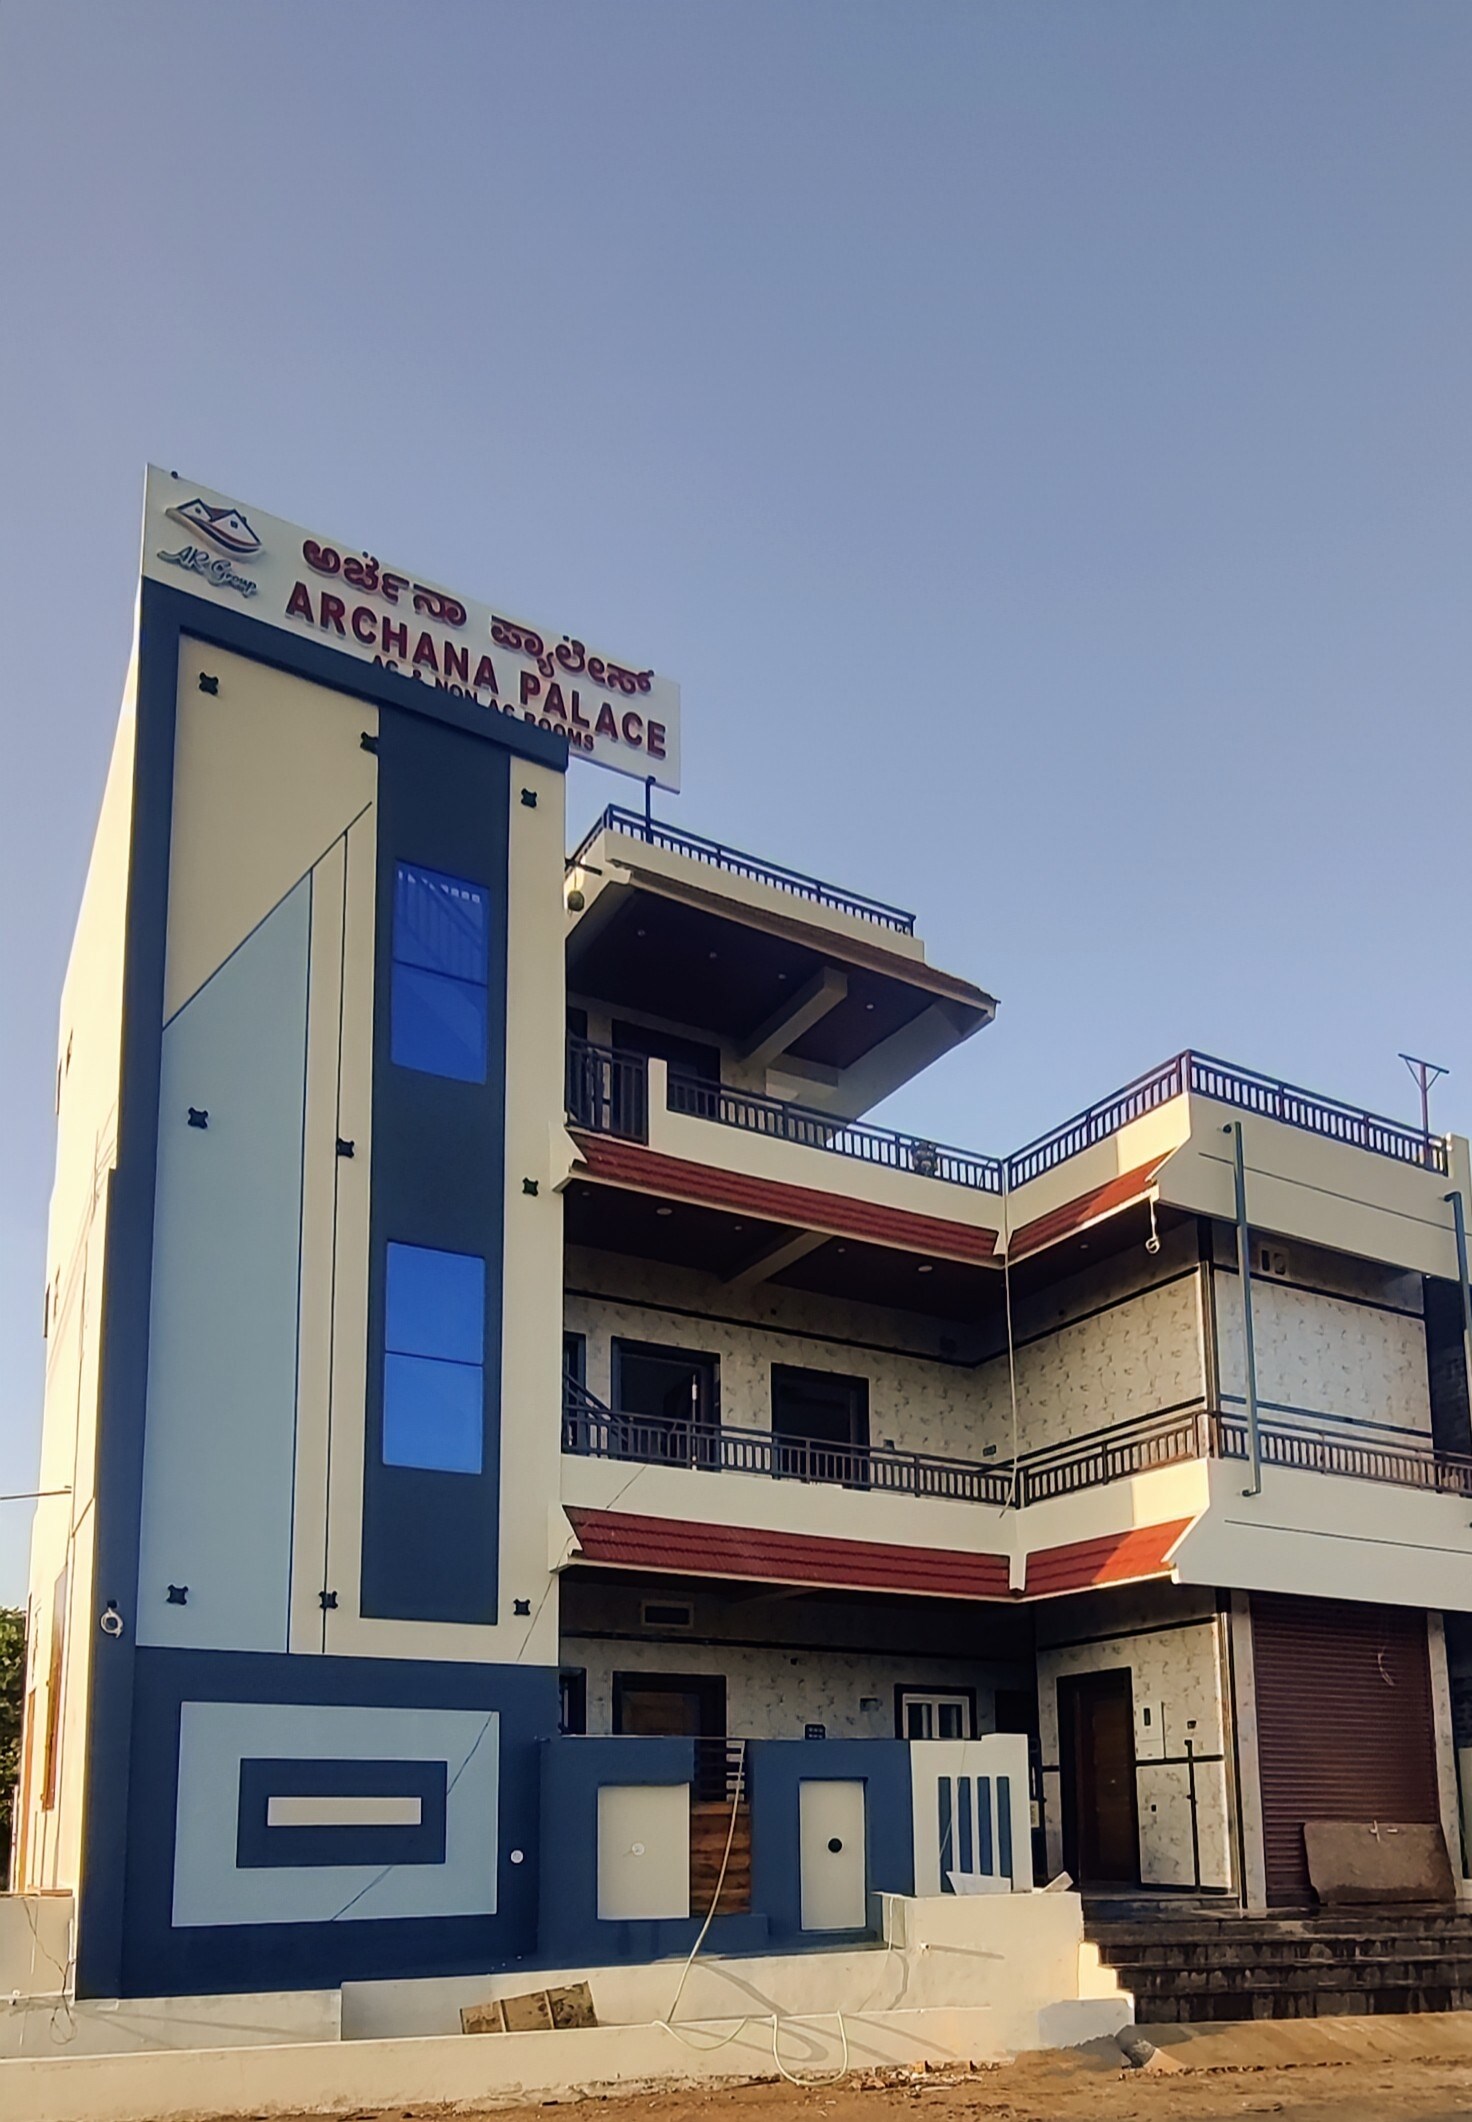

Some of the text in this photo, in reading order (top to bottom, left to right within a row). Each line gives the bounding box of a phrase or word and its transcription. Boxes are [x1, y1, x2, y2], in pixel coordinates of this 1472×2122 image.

[209, 559, 258, 598] Group
[302, 539, 655, 695] ಅರ್ಚನಾ ಪ್ಯಾಲೇಸ್
[285, 581, 666, 759] ARCHANA PALACE
